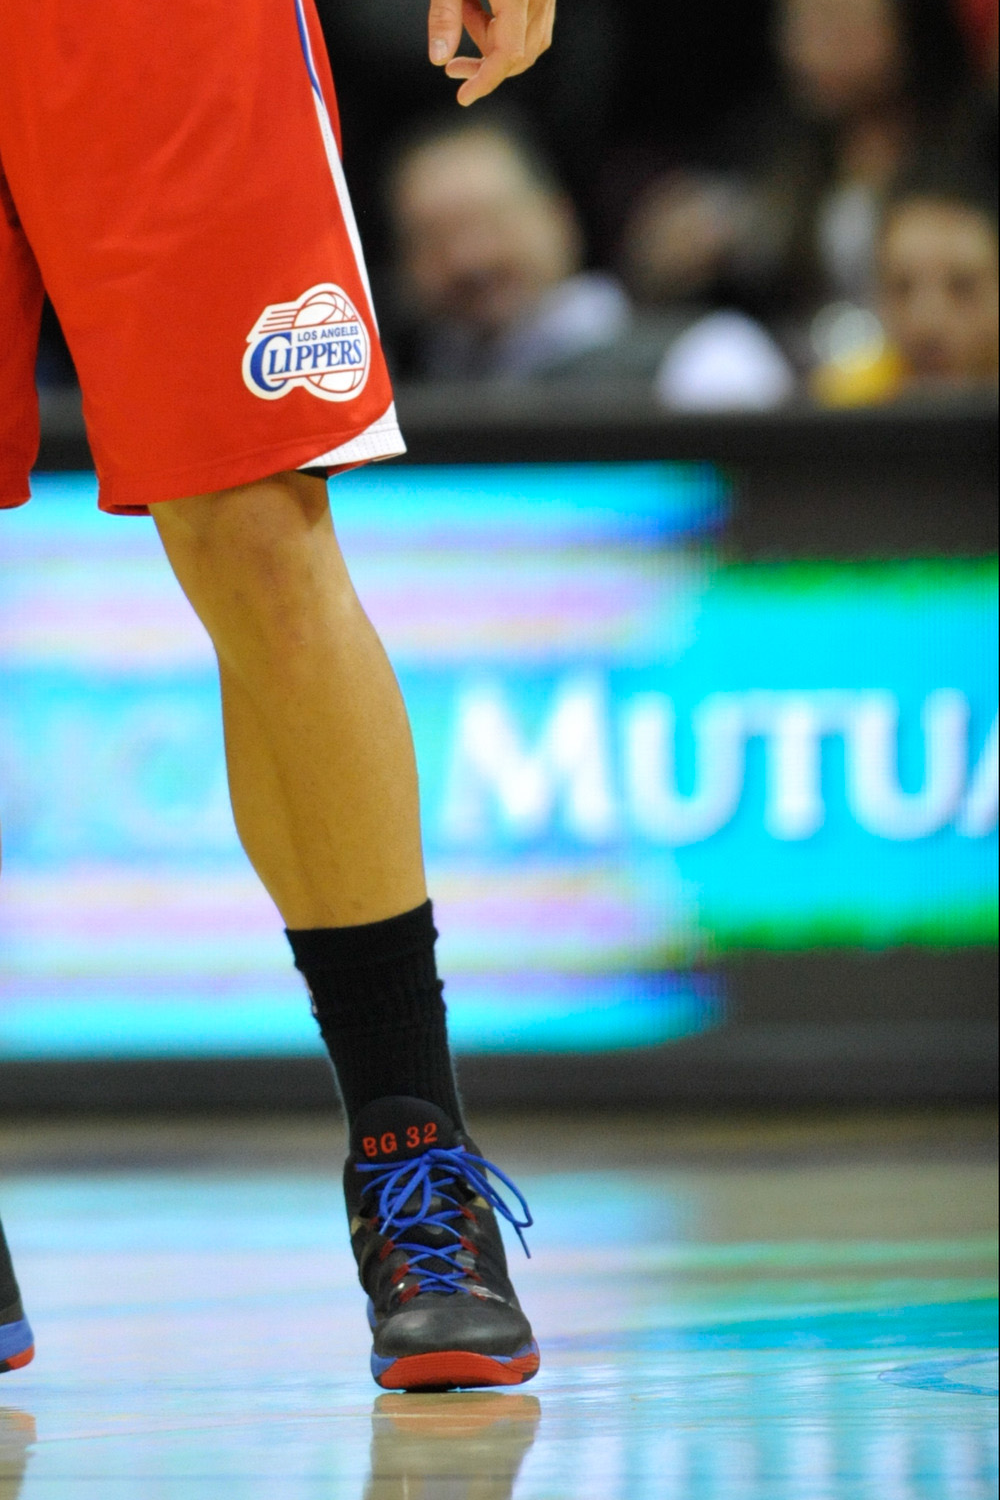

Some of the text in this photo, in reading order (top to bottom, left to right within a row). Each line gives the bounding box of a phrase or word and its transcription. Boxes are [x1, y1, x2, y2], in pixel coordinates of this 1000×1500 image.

[297, 325, 359, 342] LOS ANGELES
[250, 332, 362, 392] CLIPPERS
[362, 1122, 438, 1157] BG 32
